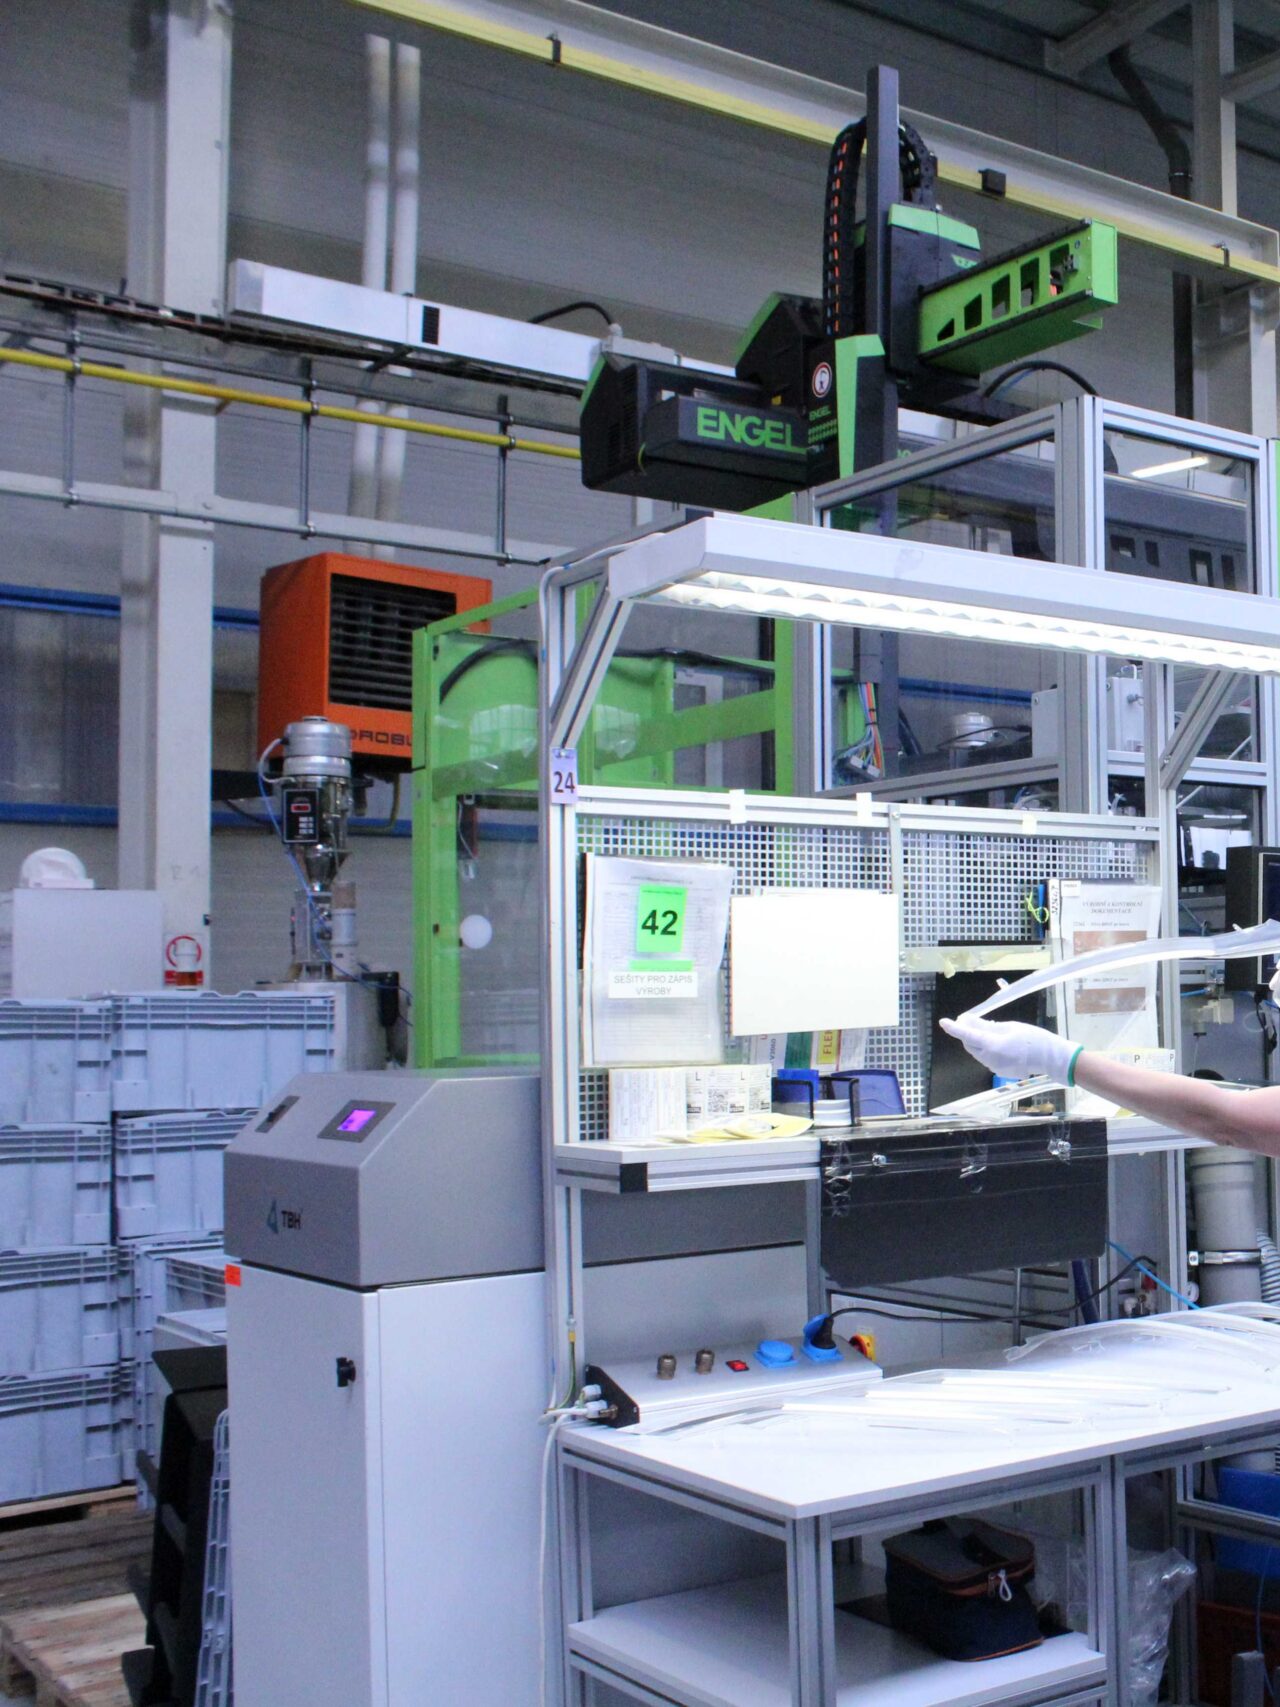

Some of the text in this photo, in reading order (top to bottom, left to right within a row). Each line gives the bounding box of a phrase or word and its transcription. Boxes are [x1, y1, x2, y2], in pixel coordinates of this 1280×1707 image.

[809, 405, 831, 421] ENGEL
[697, 406, 807, 455] ENGEL
[553, 770, 576, 794] 24
[641, 909, 678, 936] 42
[614, 973, 693, 984] SEŠITY PRO ZÁPIS
[637, 985, 672, 996] VÝROBY
[1134, 1054, 1141, 1063] P
[281, 1210, 302, 1230] TBH
